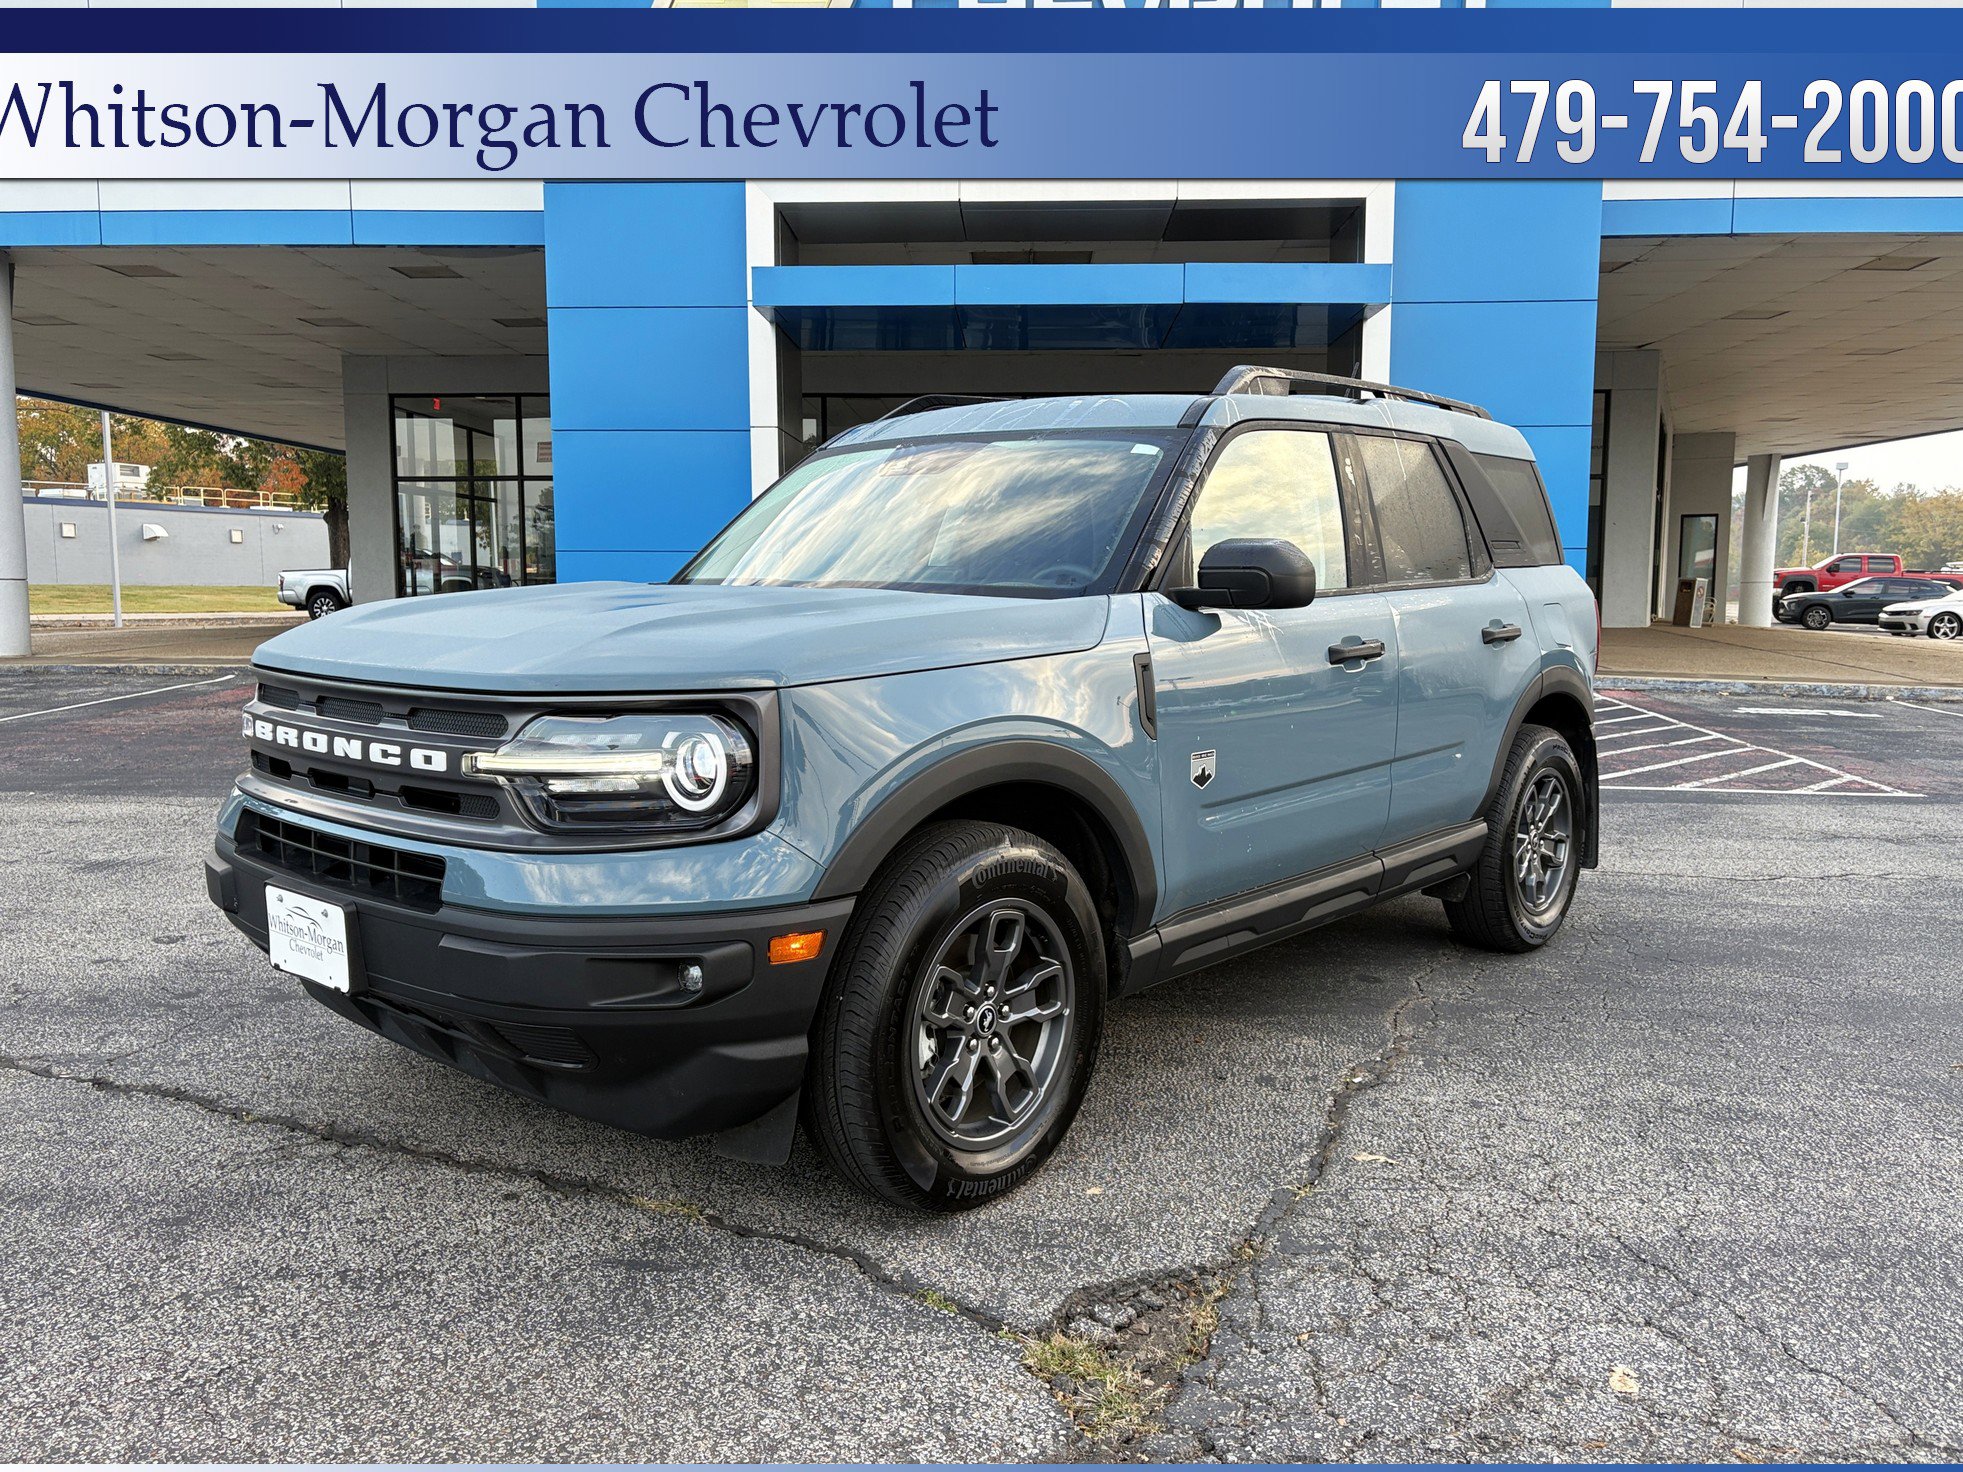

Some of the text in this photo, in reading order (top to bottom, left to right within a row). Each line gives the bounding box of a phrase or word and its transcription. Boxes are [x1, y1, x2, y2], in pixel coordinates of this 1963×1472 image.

[255, 720, 448, 772] BRONCO
[971, 857, 1048, 890] Continental
[268, 913, 344, 955] Whitson-Morgan
[289, 938, 324, 961] Chevrolet
